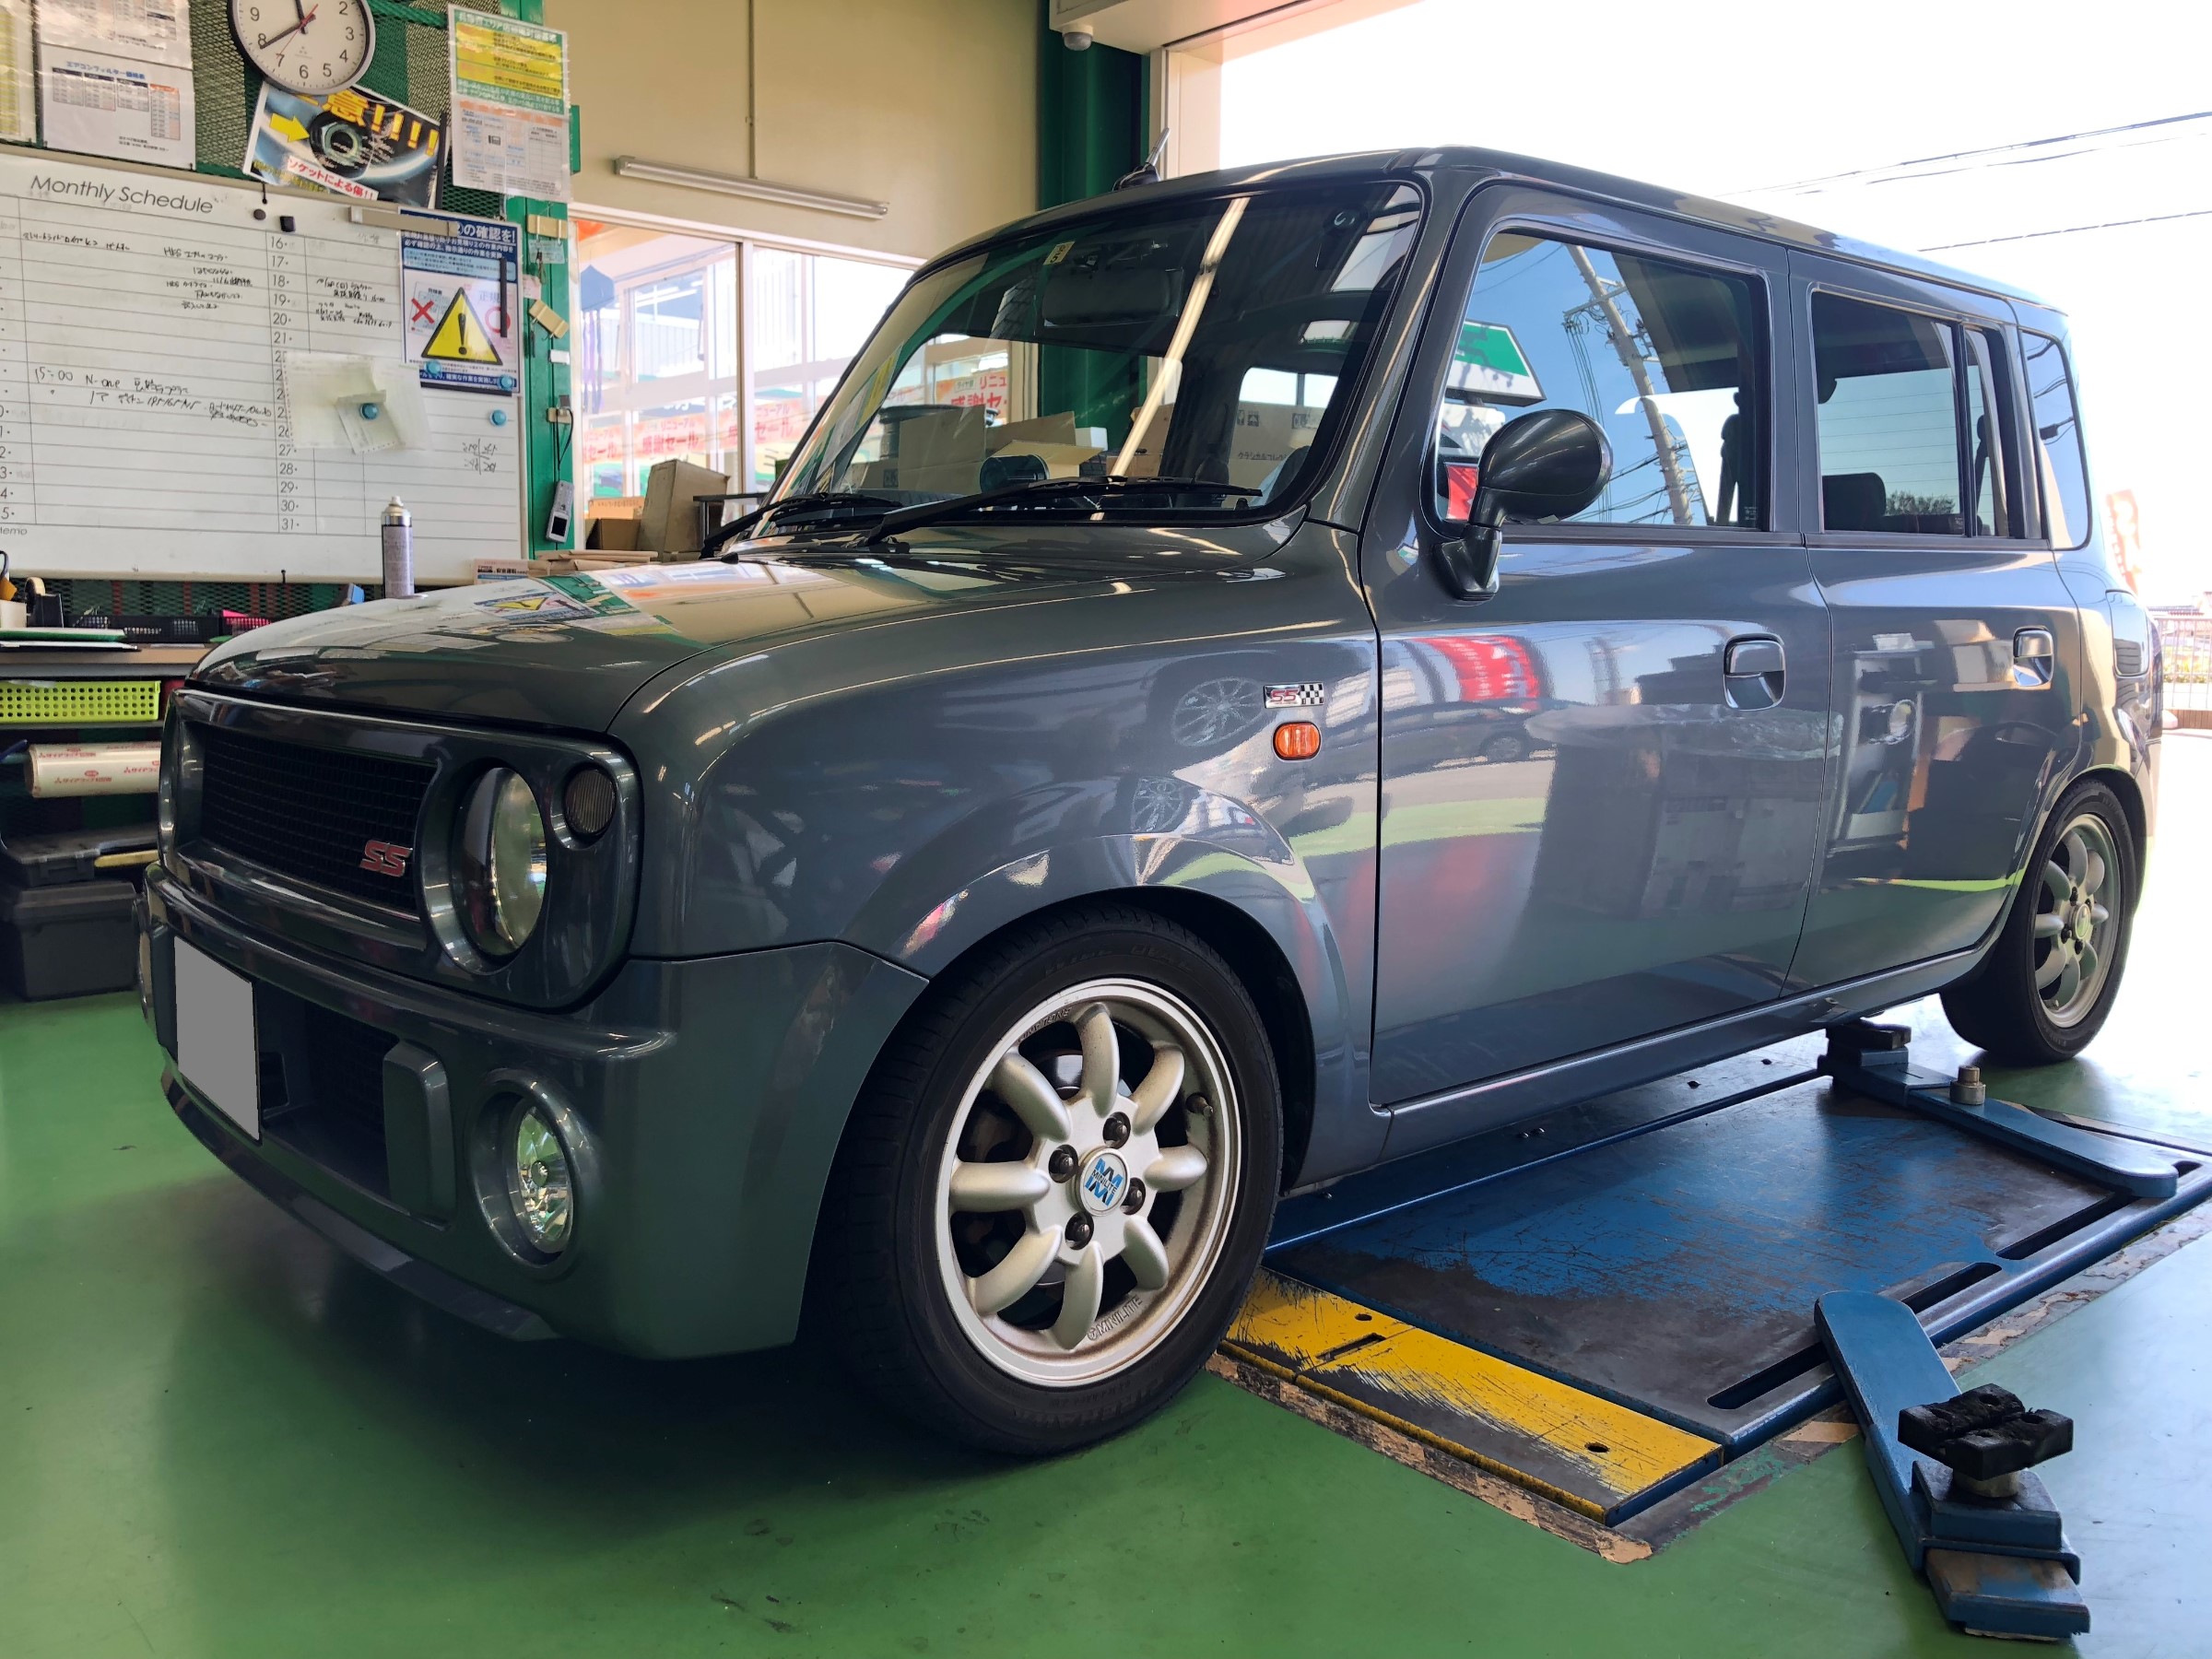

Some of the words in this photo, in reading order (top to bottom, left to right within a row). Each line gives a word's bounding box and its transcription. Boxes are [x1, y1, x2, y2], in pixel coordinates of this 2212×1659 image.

[250, 6, 260, 21] 9
[338, 1, 348, 16] 2
[258, 33, 267, 48] 8
[345, 27, 355, 41] 3
[276, 53, 285, 67] 7
[339, 49, 349, 63] 4
[299, 65, 309, 79] 6
[323, 63, 332, 77] 5
[30, 174, 115, 202] Monthly
[118, 186, 213, 214] Schedule
[279, 462, 294, 476] 28
[280, 481, 295, 494] 29
[281, 500, 295, 512] 30
[281, 518, 294, 531] 31
[359, 839, 413, 878] SS
[1090, 1169, 1118, 1195] MINILITE
